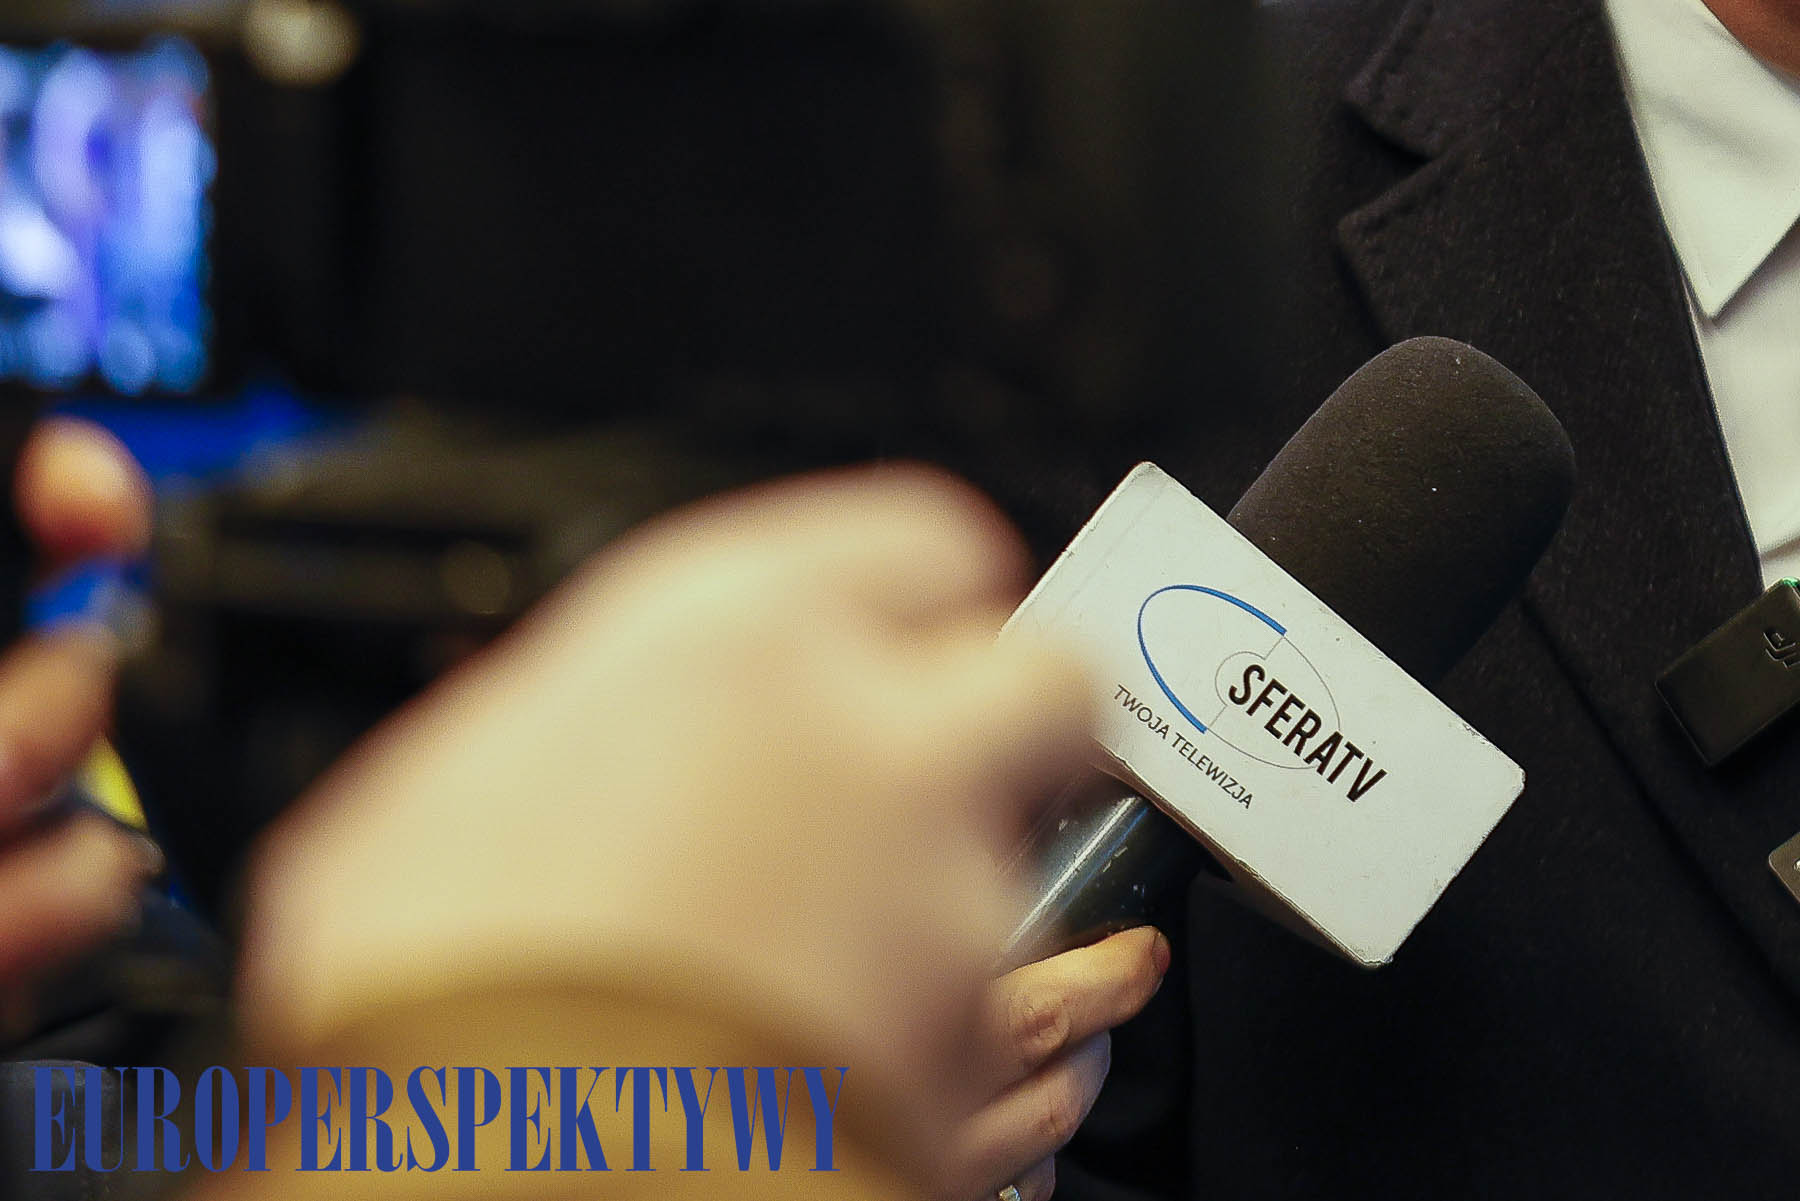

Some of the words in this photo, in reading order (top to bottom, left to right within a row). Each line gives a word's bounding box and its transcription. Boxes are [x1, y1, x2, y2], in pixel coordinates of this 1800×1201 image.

[1113, 684, 1171, 741] TWOJA
[1171, 732, 1254, 810] TELEWIZJA
[1229, 664, 1388, 803] SFERATV
